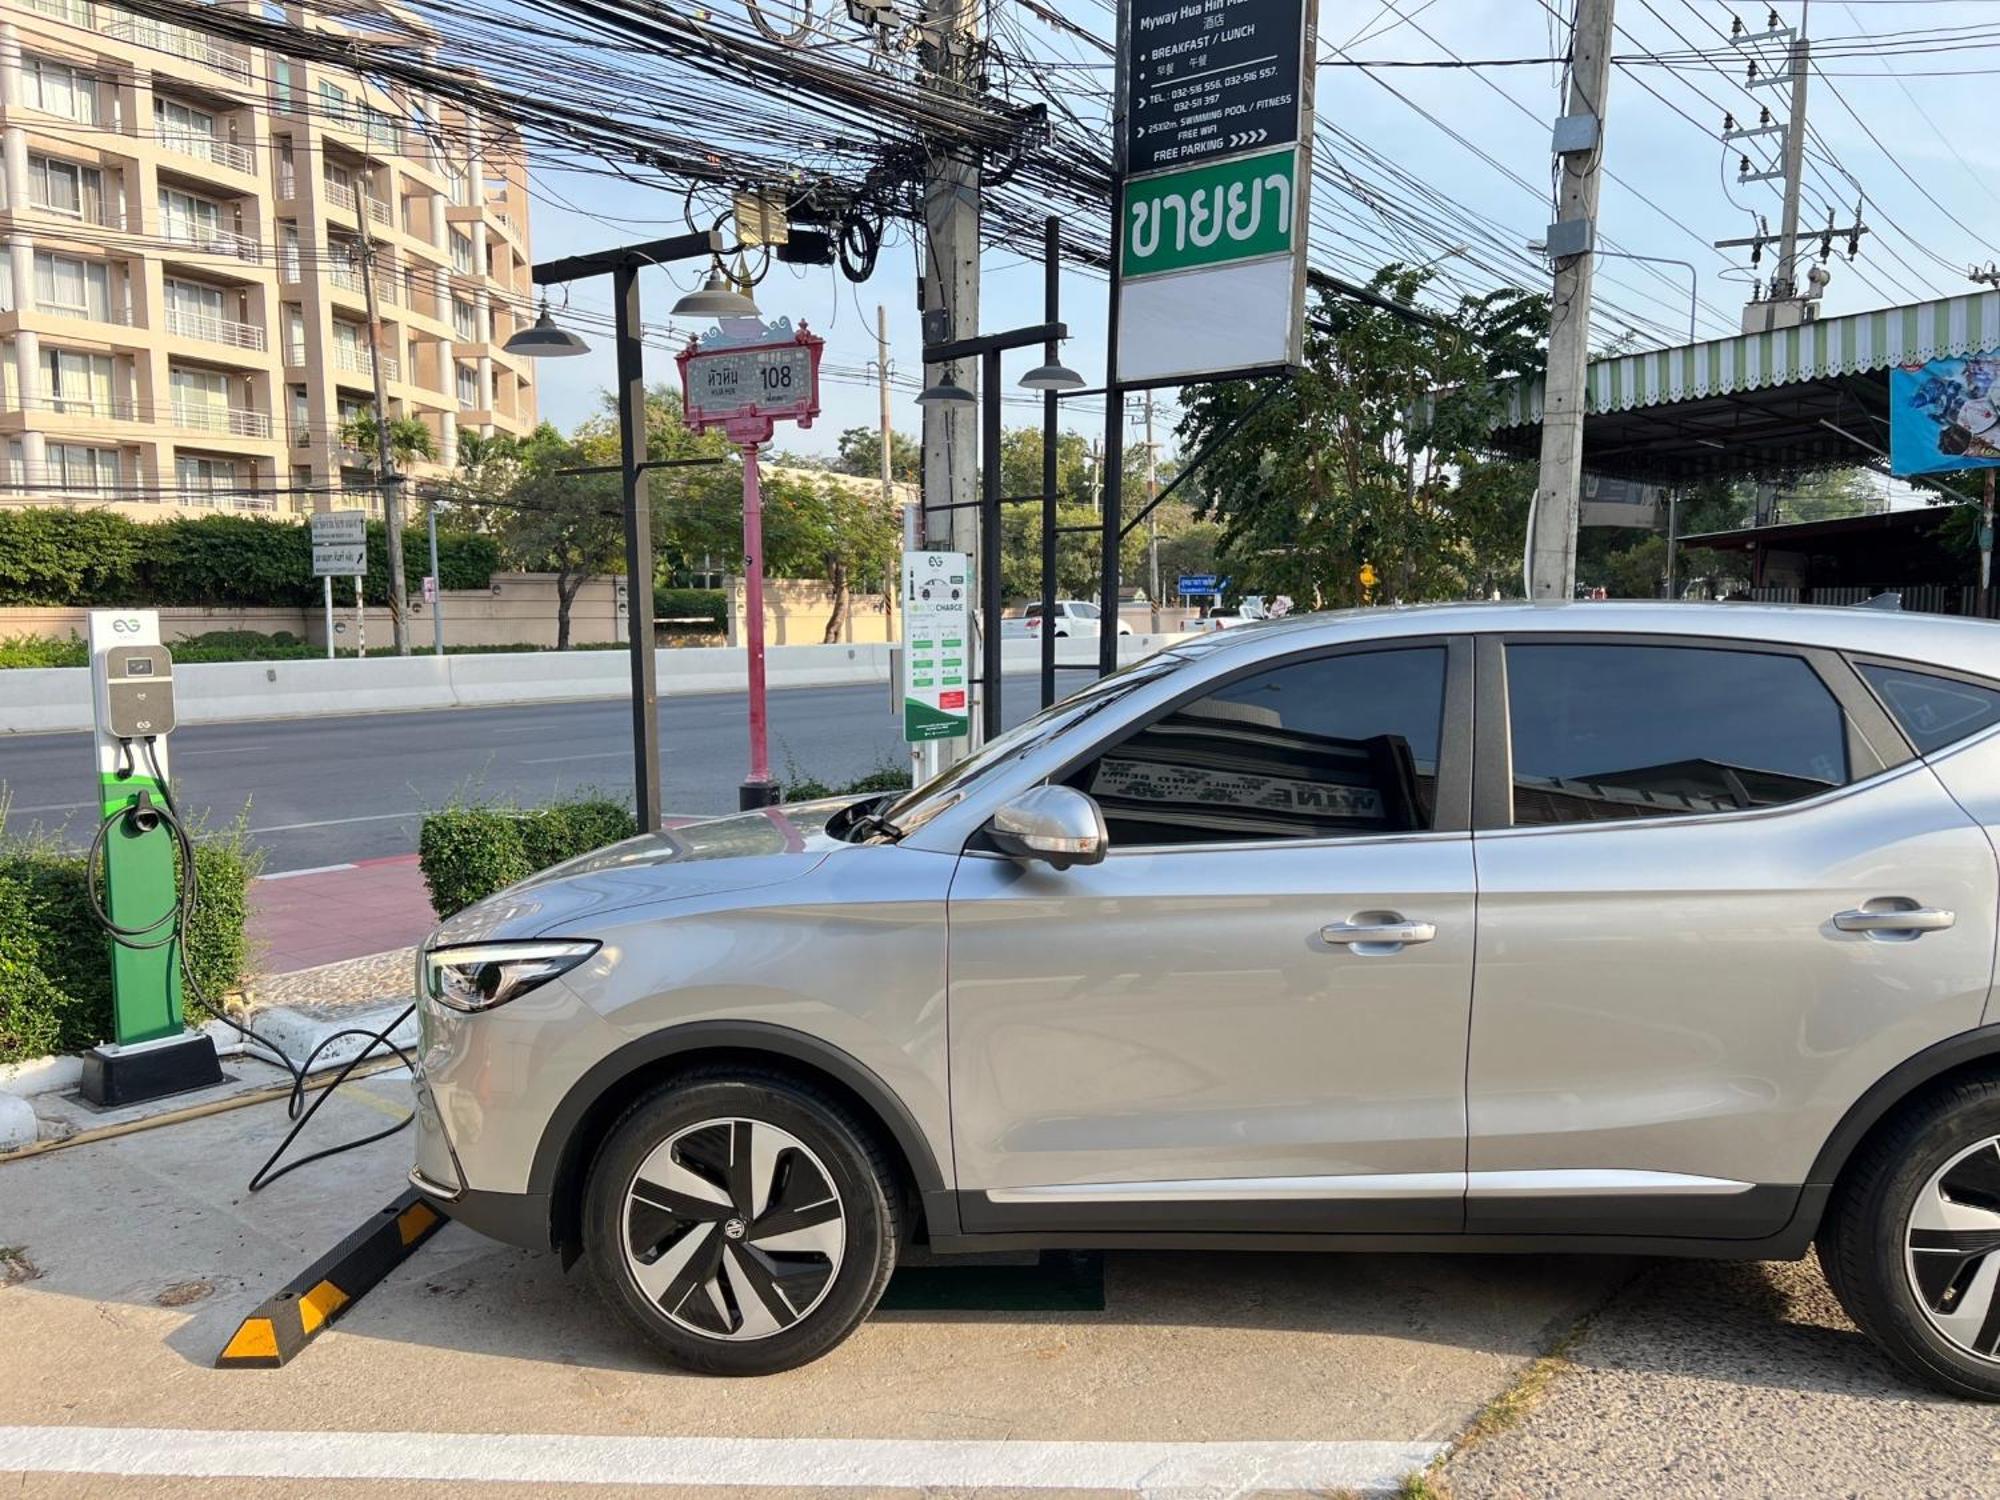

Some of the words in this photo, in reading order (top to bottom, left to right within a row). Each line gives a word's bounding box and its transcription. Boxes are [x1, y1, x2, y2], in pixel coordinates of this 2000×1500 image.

[1140, 10, 1178, 31] Myway
[1180, 5, 1202, 19] Hua
[1205, 0, 1224, 13] Hin
[1203, 13, 1225, 30] 酒店
[1152, 35, 1210, 60] BREAKFAST
[1212, 33, 1219, 45] /
[1221, 24, 1256, 42] LUNCH
[1171, 86, 1203, 99] 032-516
[1224, 74, 1257, 86] 032-516
[1180, 110, 1223, 127] SWIMMING
[1224, 106, 1247, 117] POOL
[1256, 94, 1292, 110] FITNESS
[1204, 94, 1220, 105] 397
[1178, 130, 1198, 141] FREE
[1154, 147, 1178, 162] FREE
[1181, 138, 1224, 157] PARKING
[1131, 173, 1290, 258] ขายยา
[708, 367, 738, 387] หัวหิน
[760, 365, 792, 390] 108
[935, 603, 963, 612] CHARGE
